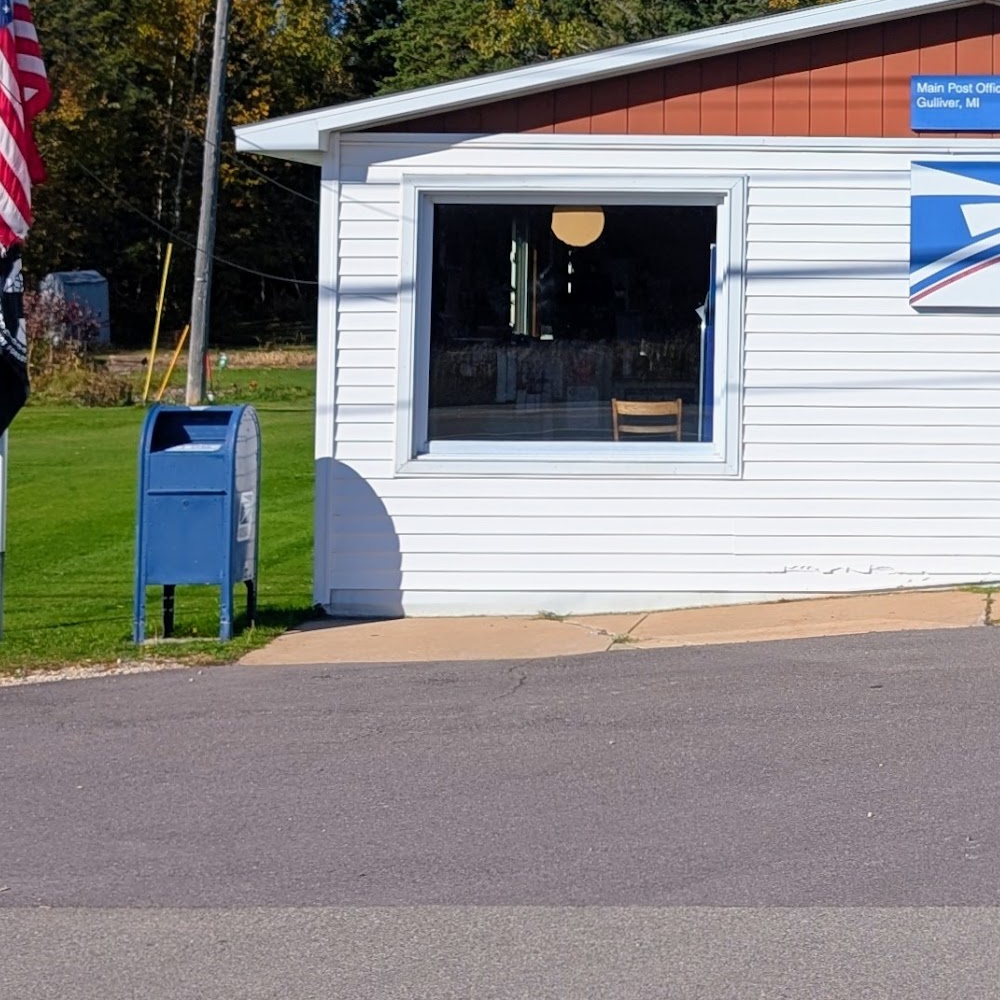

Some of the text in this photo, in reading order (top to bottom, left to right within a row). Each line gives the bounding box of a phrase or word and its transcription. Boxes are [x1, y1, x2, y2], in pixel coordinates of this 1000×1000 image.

[916, 82, 945, 94] Main
[948, 82, 973, 94] Post
[916, 97, 980, 109] Gulliver, MI
